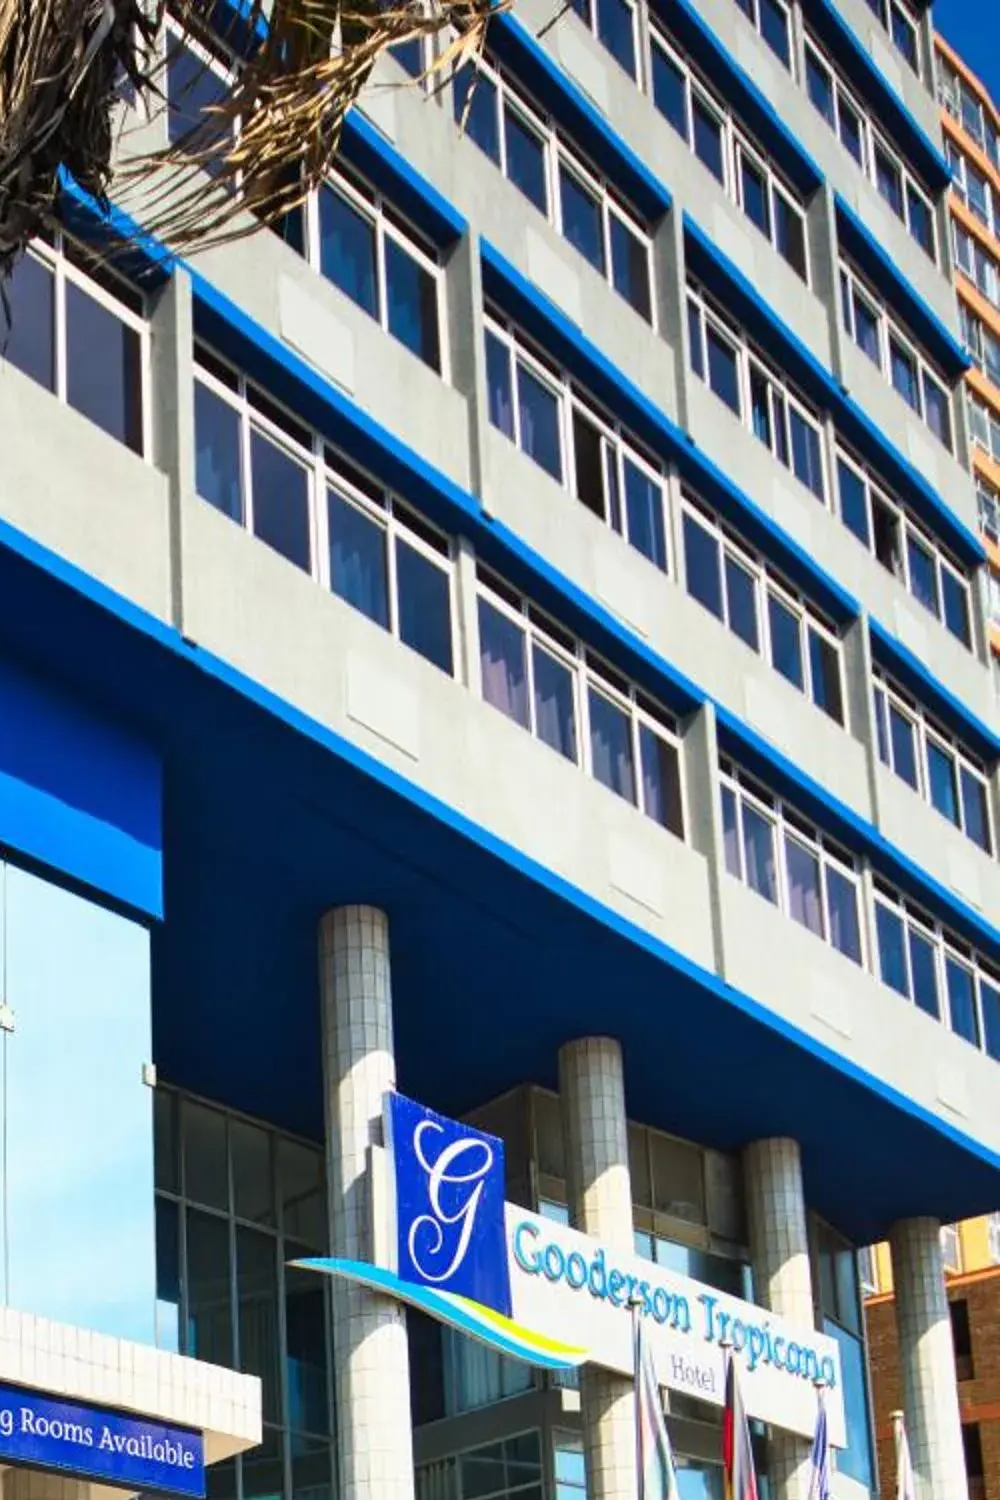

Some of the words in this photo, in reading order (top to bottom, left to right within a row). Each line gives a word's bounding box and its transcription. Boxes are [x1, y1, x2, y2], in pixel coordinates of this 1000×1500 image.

[512, 1219, 692, 1334] Gooderson
[696, 1294, 837, 1388] Tropicana
[671, 1354, 716, 1393] Hotel
[20, 1409, 94, 1447] Rooms
[99, 1427, 195, 1469] Available
